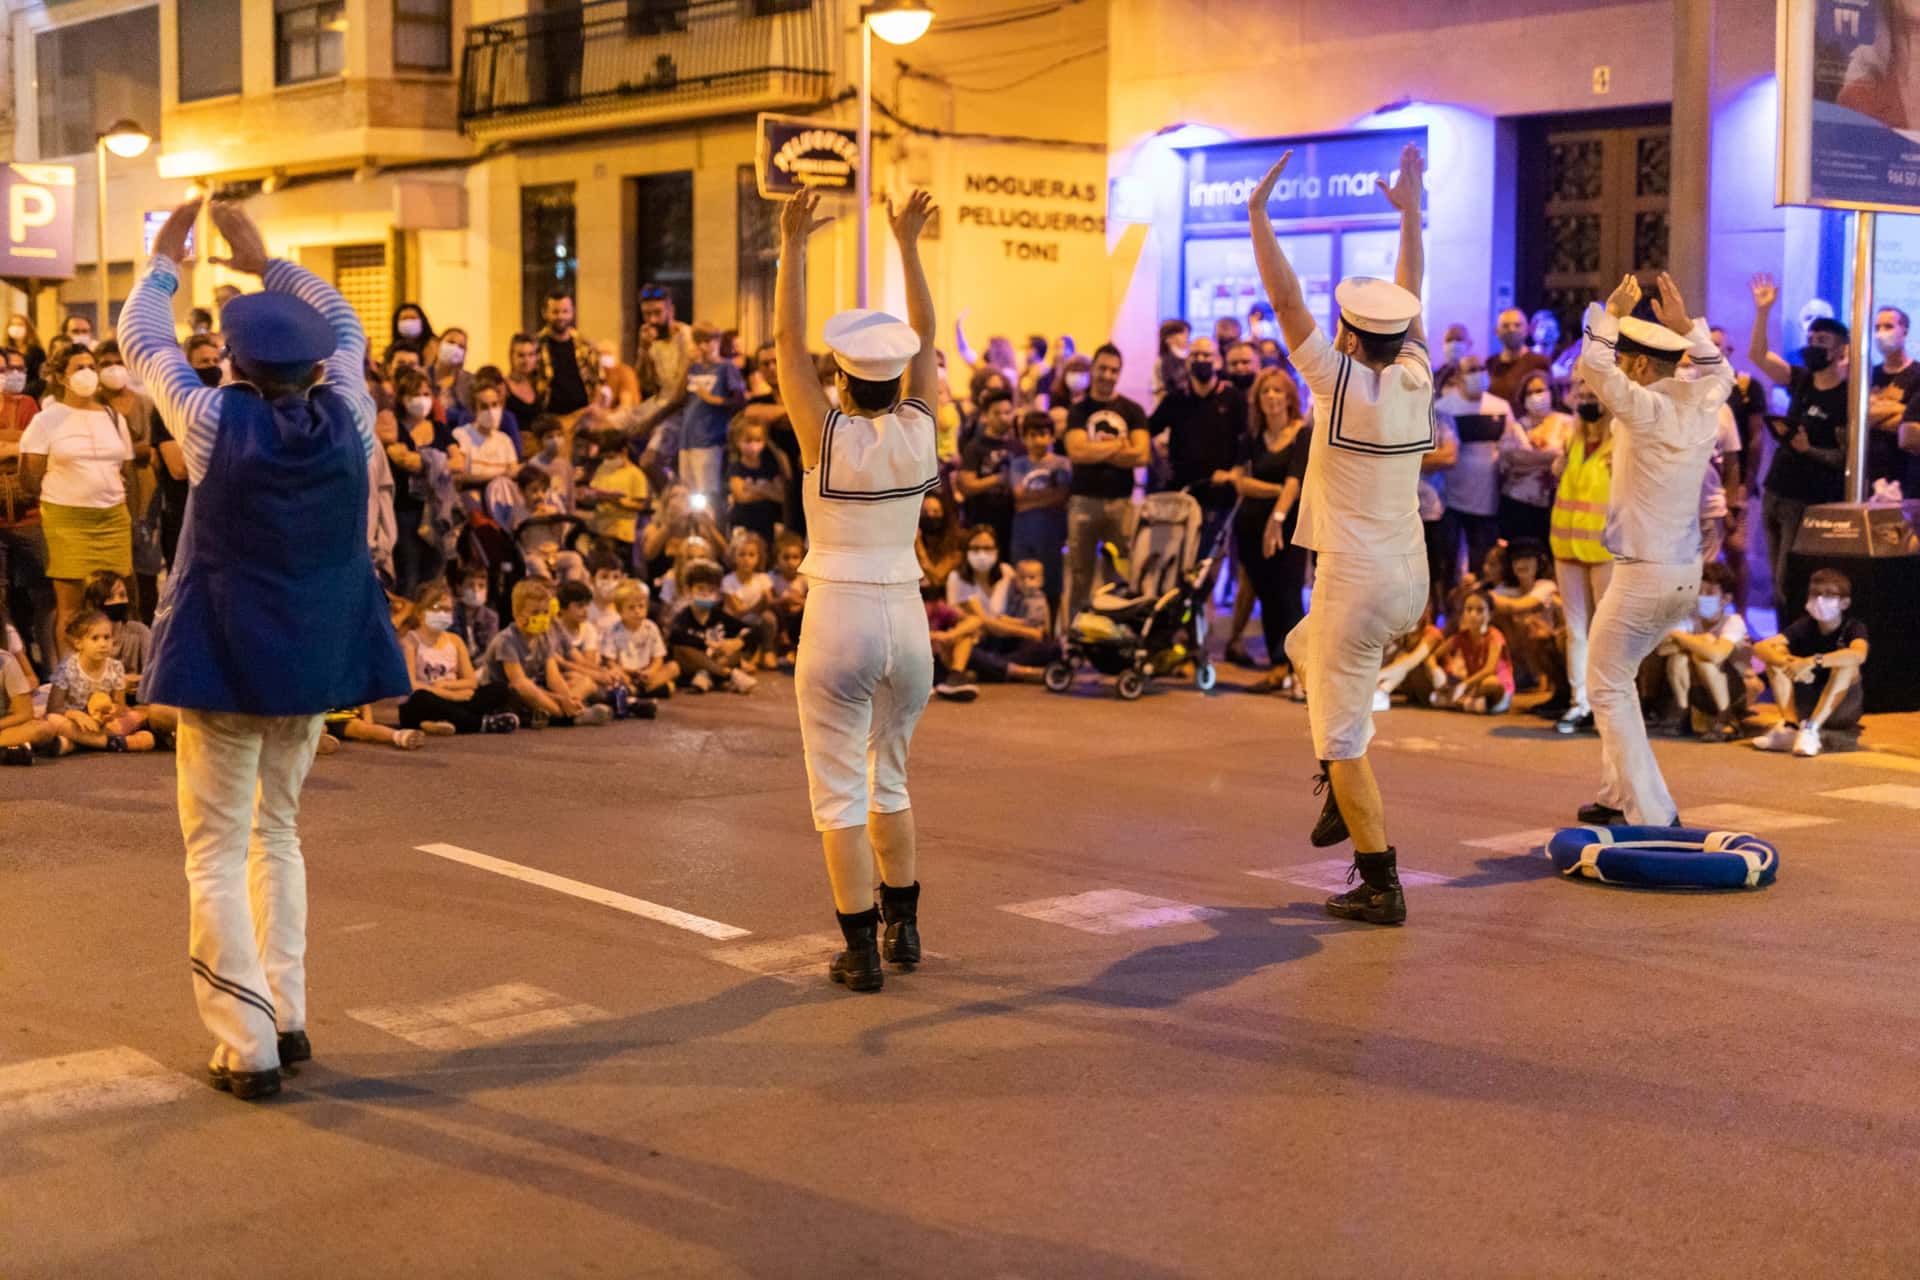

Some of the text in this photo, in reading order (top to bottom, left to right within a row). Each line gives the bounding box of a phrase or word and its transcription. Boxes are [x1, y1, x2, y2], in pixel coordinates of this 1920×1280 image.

[965, 173, 1097, 203] NOGUERAS
[10, 182, 56, 243] P
[957, 205, 1107, 235] PELUQUEROS
[1002, 238, 1060, 262] TONI
